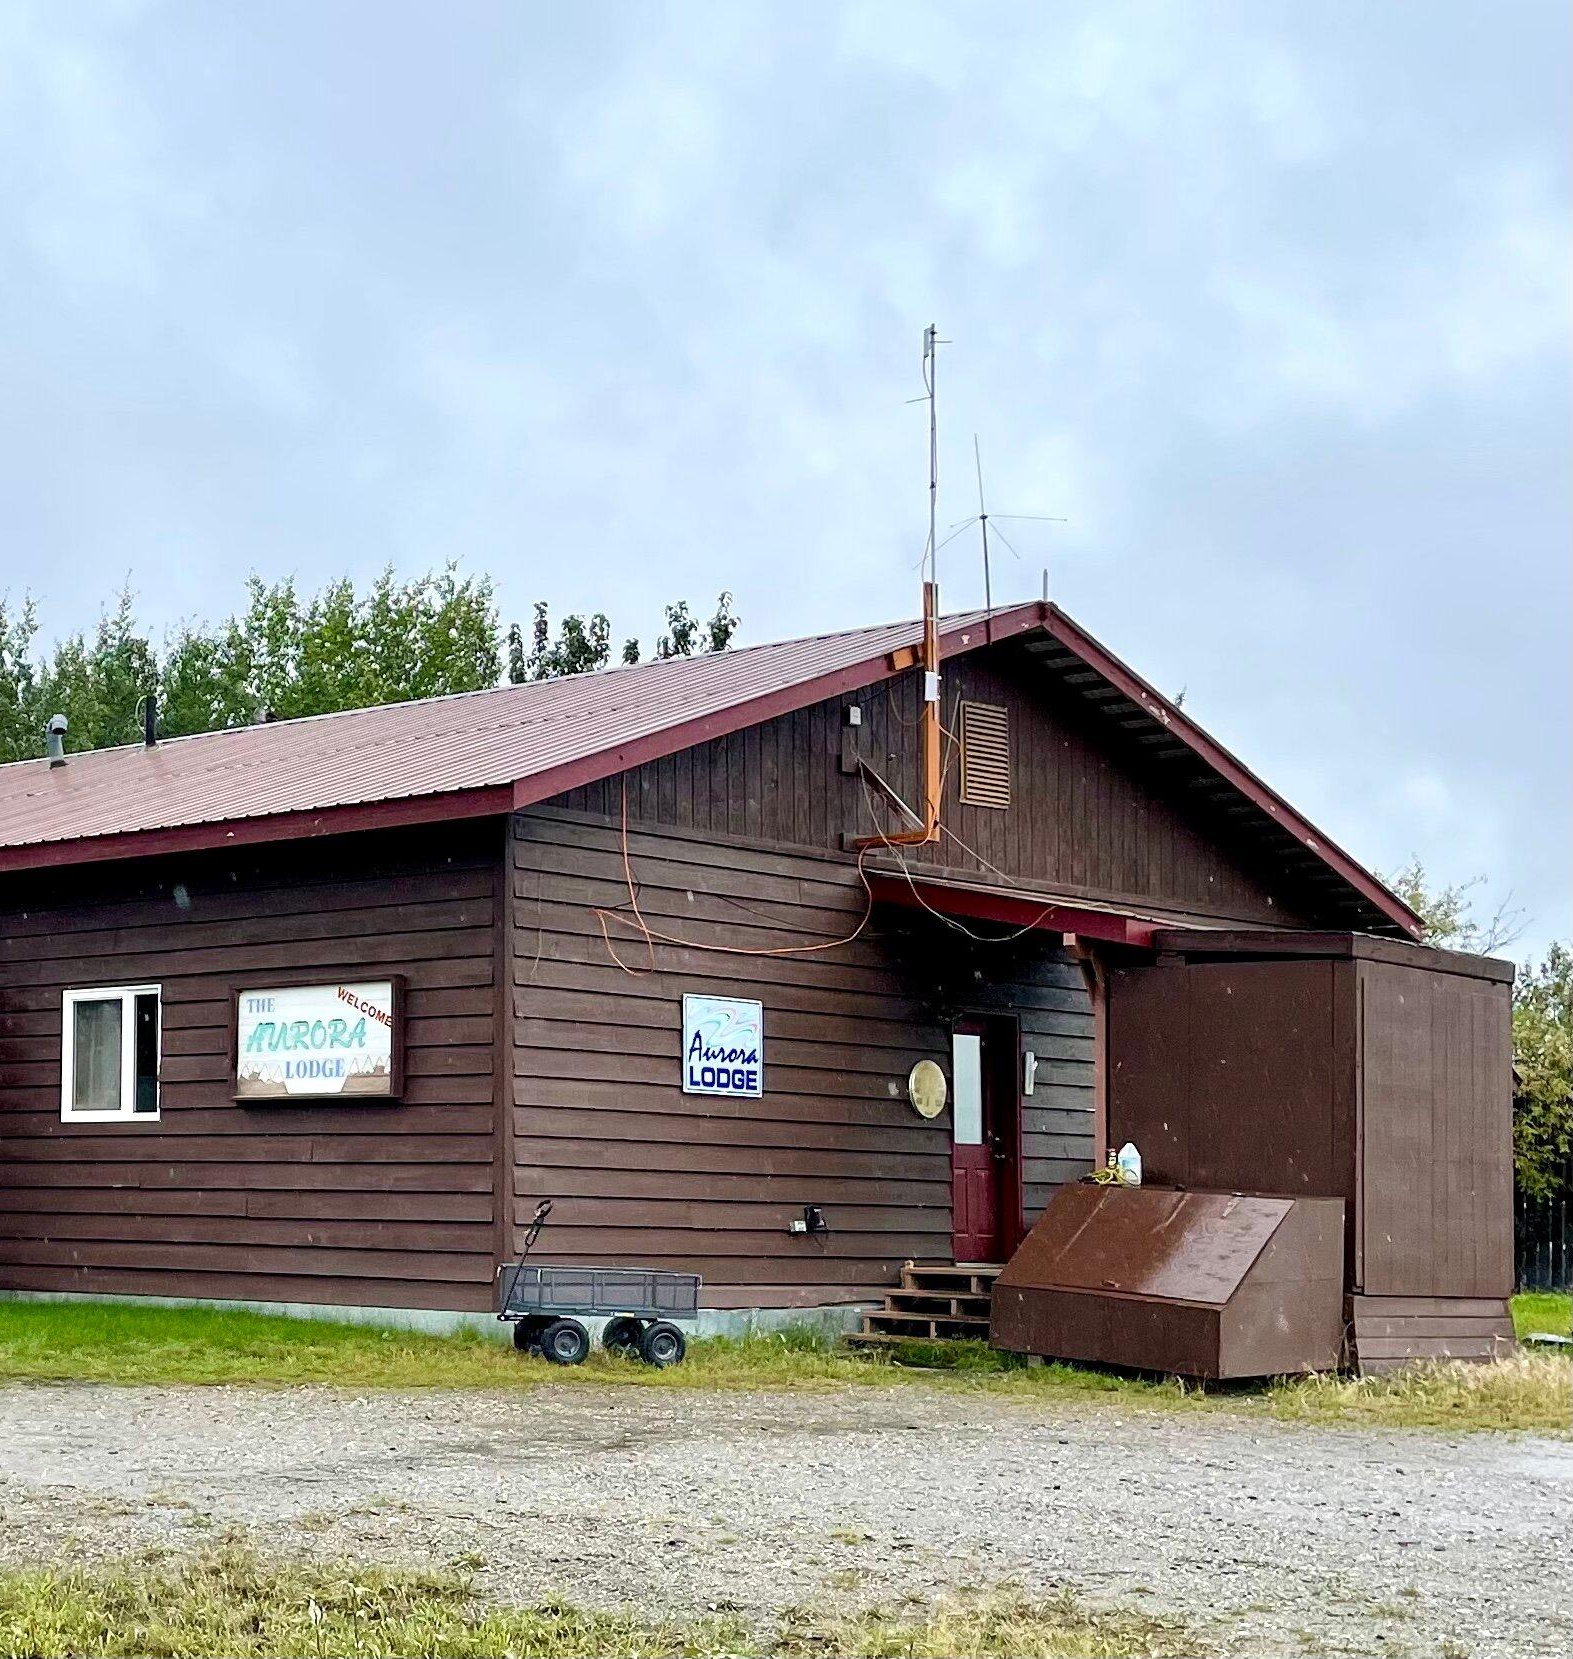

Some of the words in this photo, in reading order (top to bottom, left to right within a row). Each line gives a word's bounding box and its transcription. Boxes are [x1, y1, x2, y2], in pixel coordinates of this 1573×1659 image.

[246, 998, 276, 1013] THE
[337, 986, 393, 1028] WELCOME
[246, 1017, 367, 1053] AURORA
[688, 1029, 758, 1065] Aurora
[285, 1058, 346, 1079] LODGE
[689, 1065, 758, 1091] LODGE
